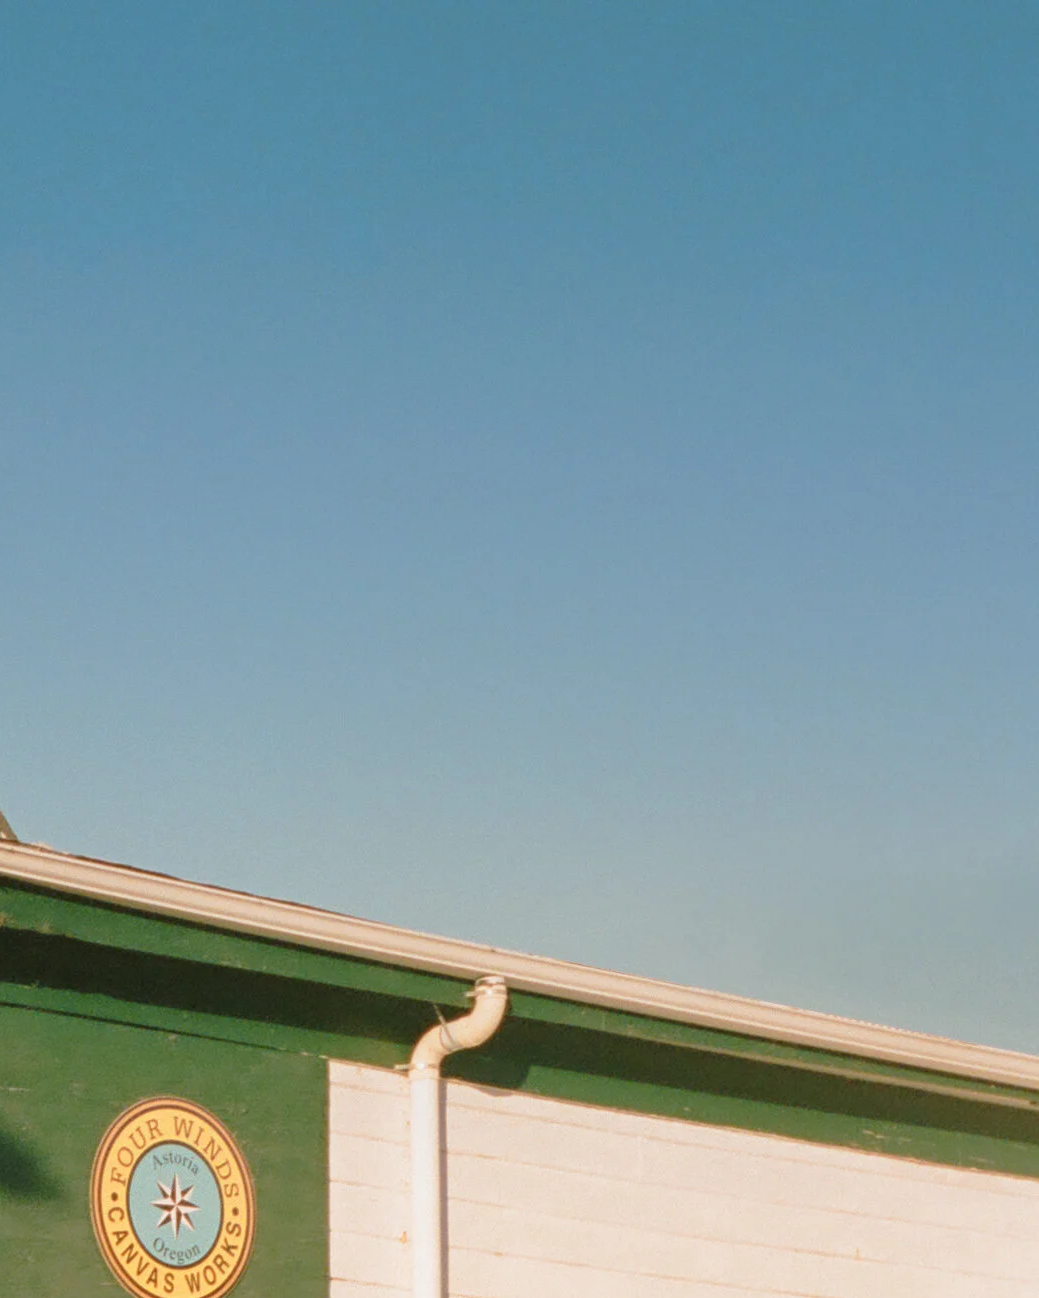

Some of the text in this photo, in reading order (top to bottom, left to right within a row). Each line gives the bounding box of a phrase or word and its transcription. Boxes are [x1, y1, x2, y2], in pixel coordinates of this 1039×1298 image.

[110, 1116, 239, 1198] FOUR WINDS
[152, 1151, 200, 1176] Astoria
[108, 1206, 242, 1294] CANVAS WORKS
[152, 1236, 201, 1265] Oregon
